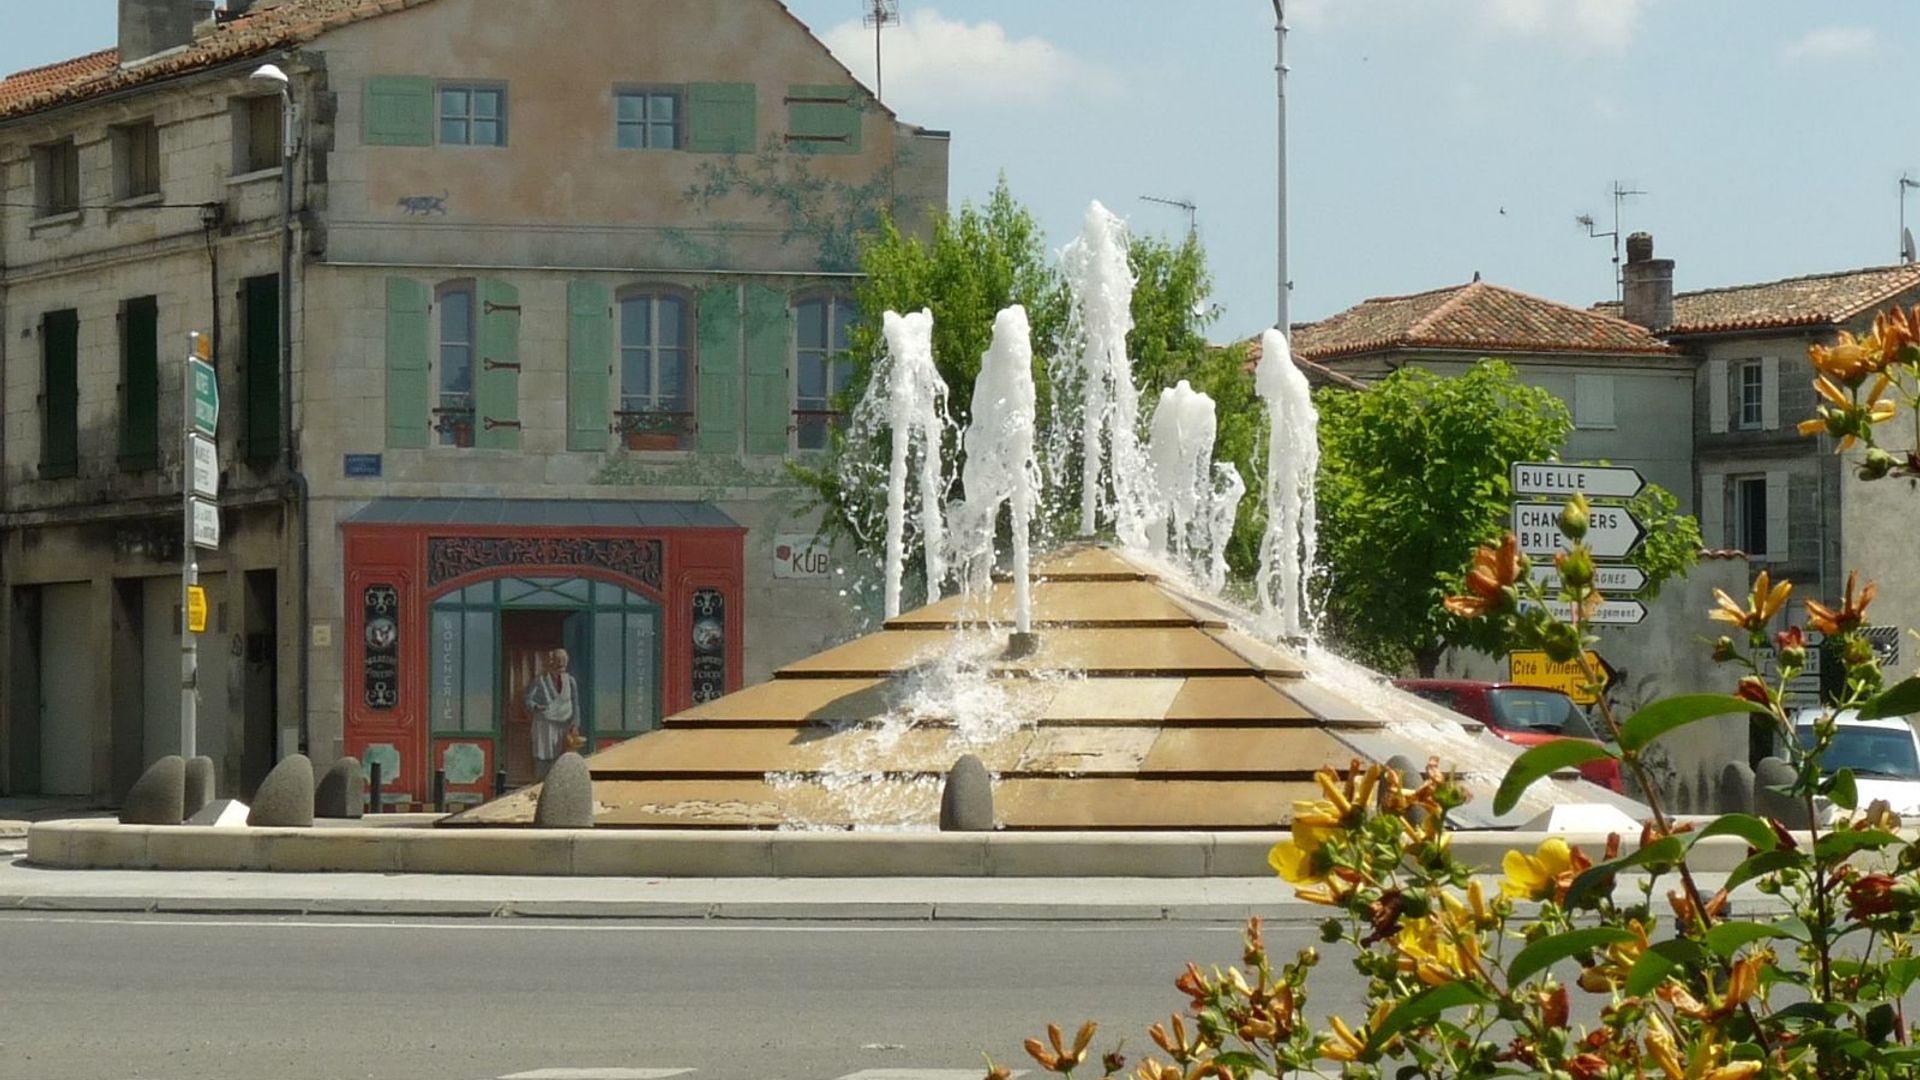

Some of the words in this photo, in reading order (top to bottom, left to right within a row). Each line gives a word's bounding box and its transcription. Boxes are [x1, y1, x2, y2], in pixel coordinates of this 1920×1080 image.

[1521, 471, 1586, 489] RUELLE
[1521, 511, 1618, 530] CHAMERS
[1521, 532, 1561, 548] BRIE
[792, 552, 829, 574] KUB
[1513, 660, 1537, 675] Cité
